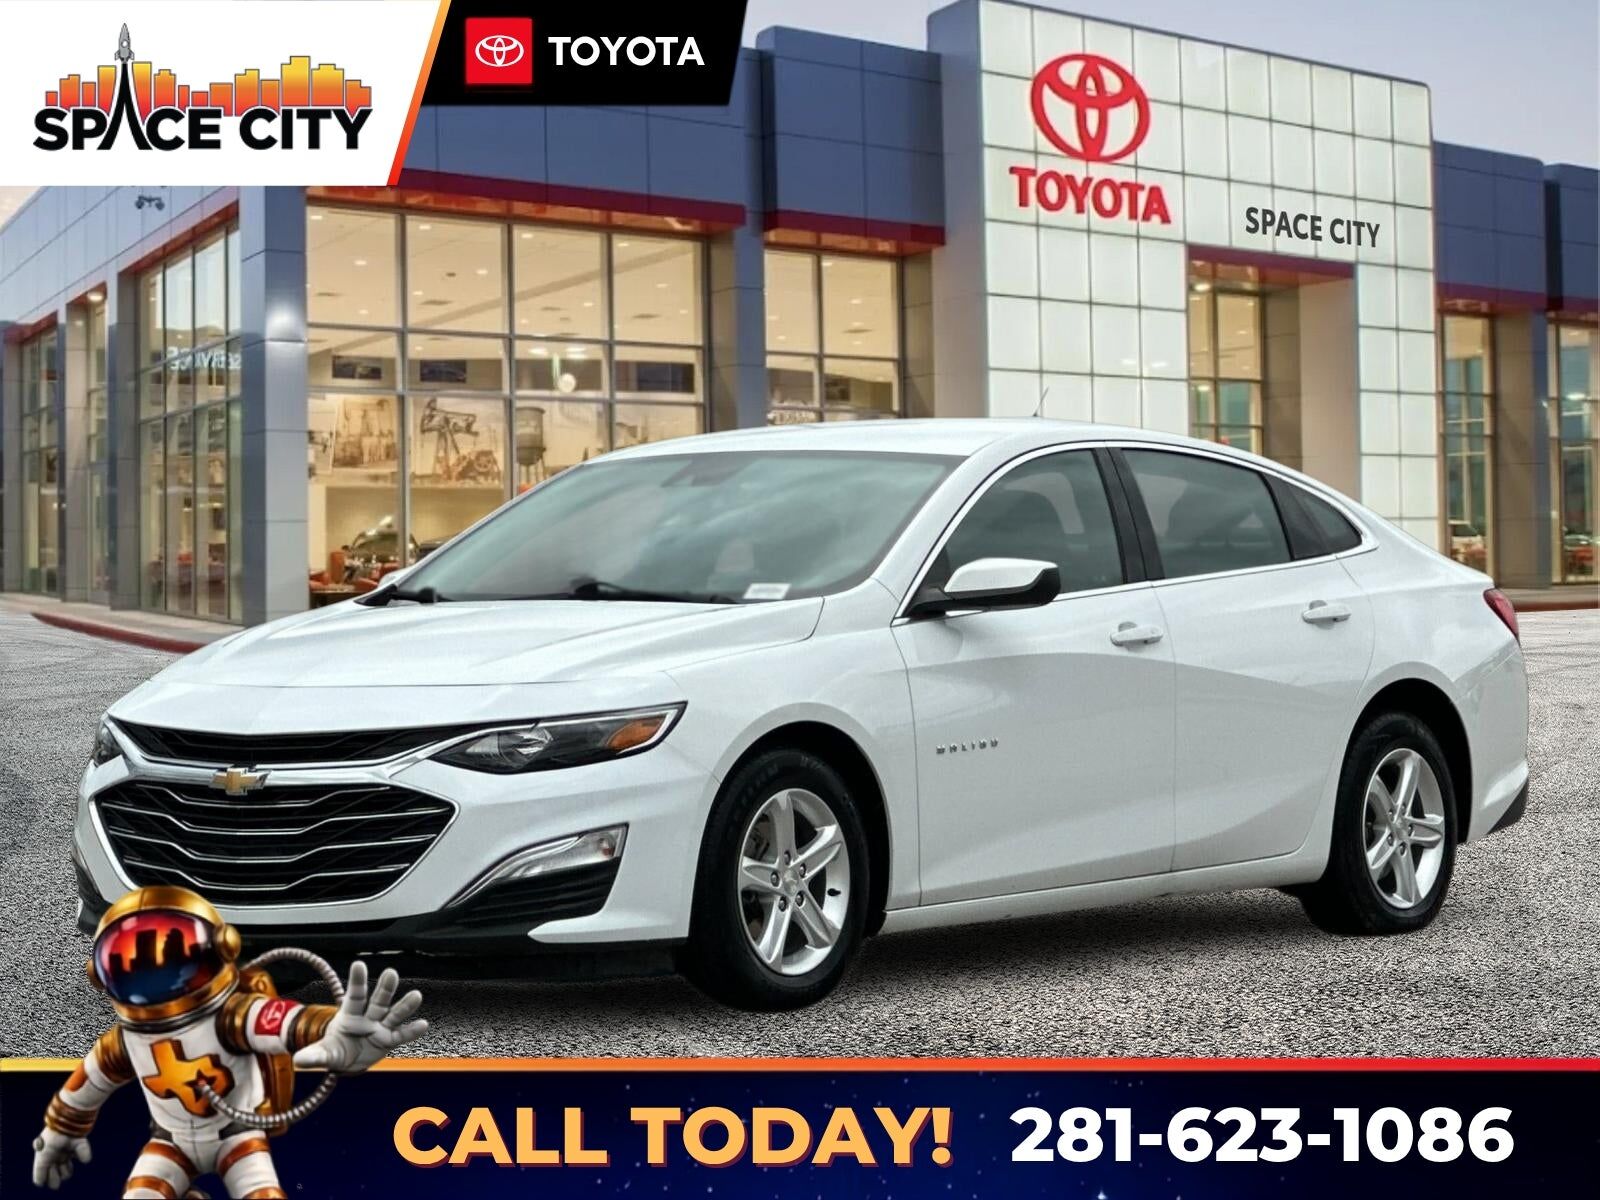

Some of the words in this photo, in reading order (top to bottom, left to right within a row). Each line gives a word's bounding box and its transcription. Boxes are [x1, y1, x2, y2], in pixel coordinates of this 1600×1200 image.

[1009, 166, 1172, 225] TOYOTA
[1245, 206, 1322, 242] SPACE
[1329, 217, 1380, 248] CITY
[936, 737, 999, 754] MALIBU
